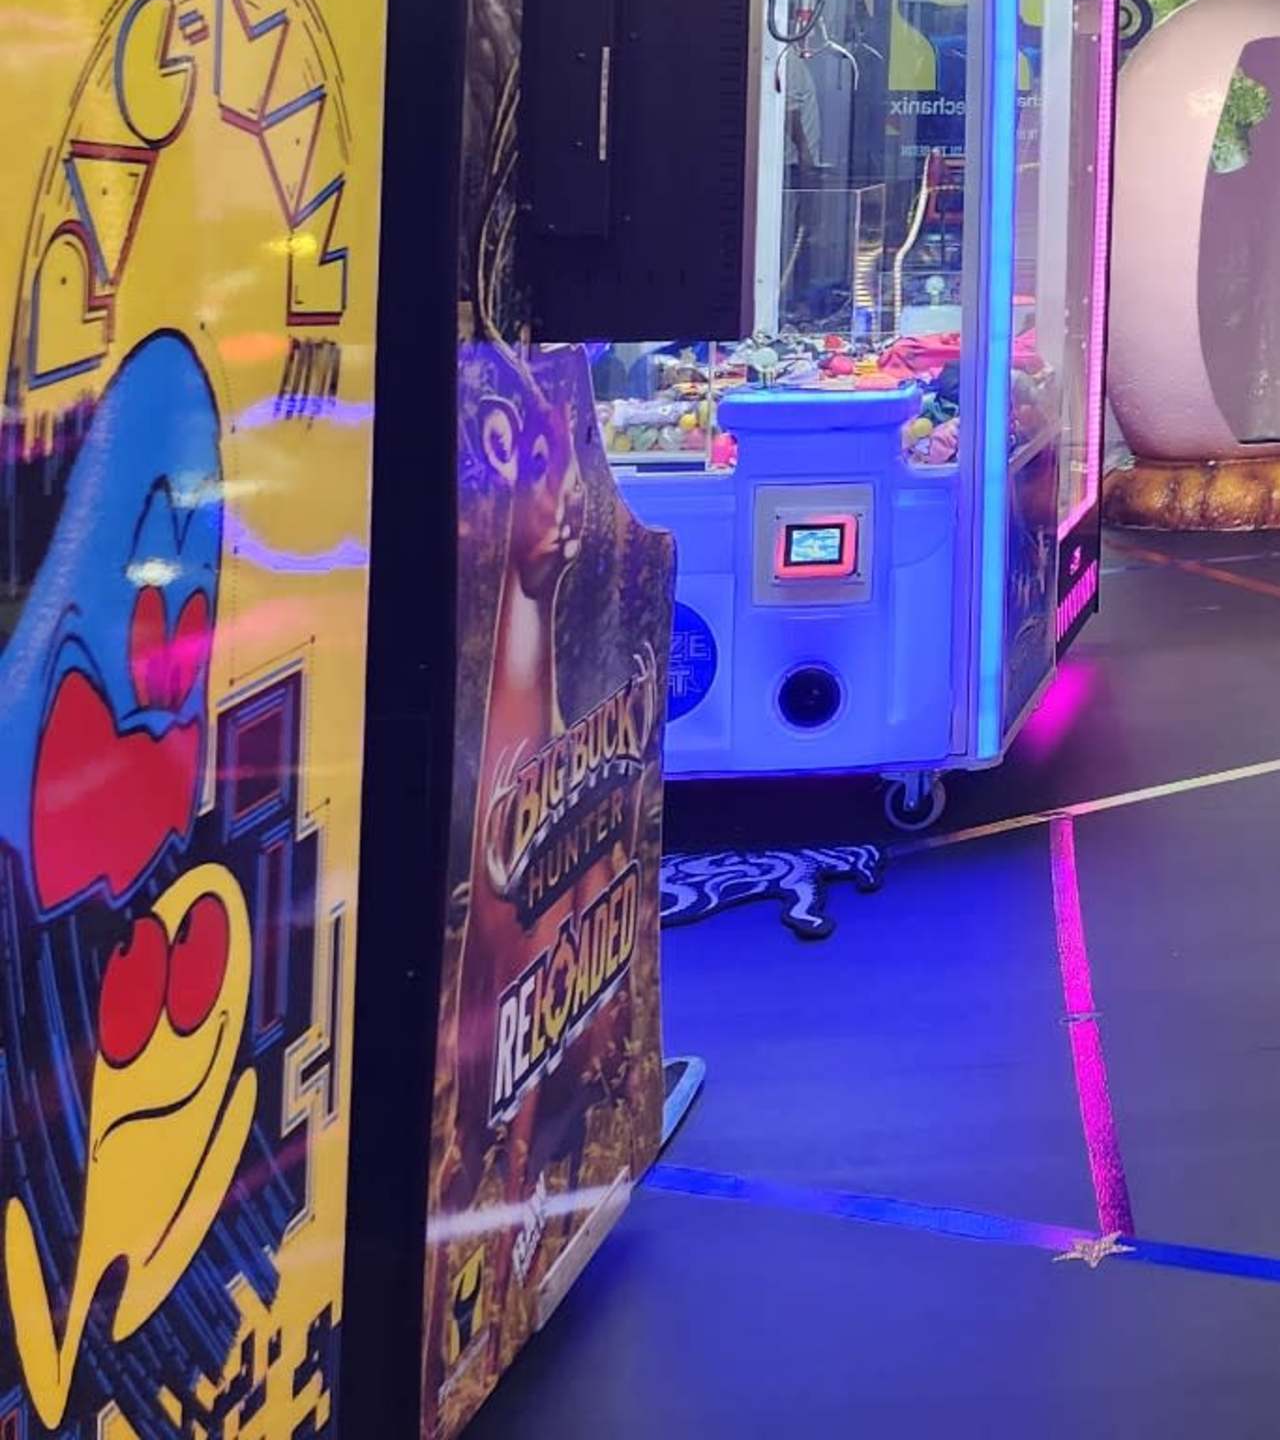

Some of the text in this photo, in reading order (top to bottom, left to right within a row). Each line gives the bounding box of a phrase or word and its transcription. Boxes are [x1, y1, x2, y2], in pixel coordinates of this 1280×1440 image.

[510, 688, 643, 872] BIG BUCK
[527, 789, 624, 909] HUNTER
[493, 872, 638, 1105] RELOADED
